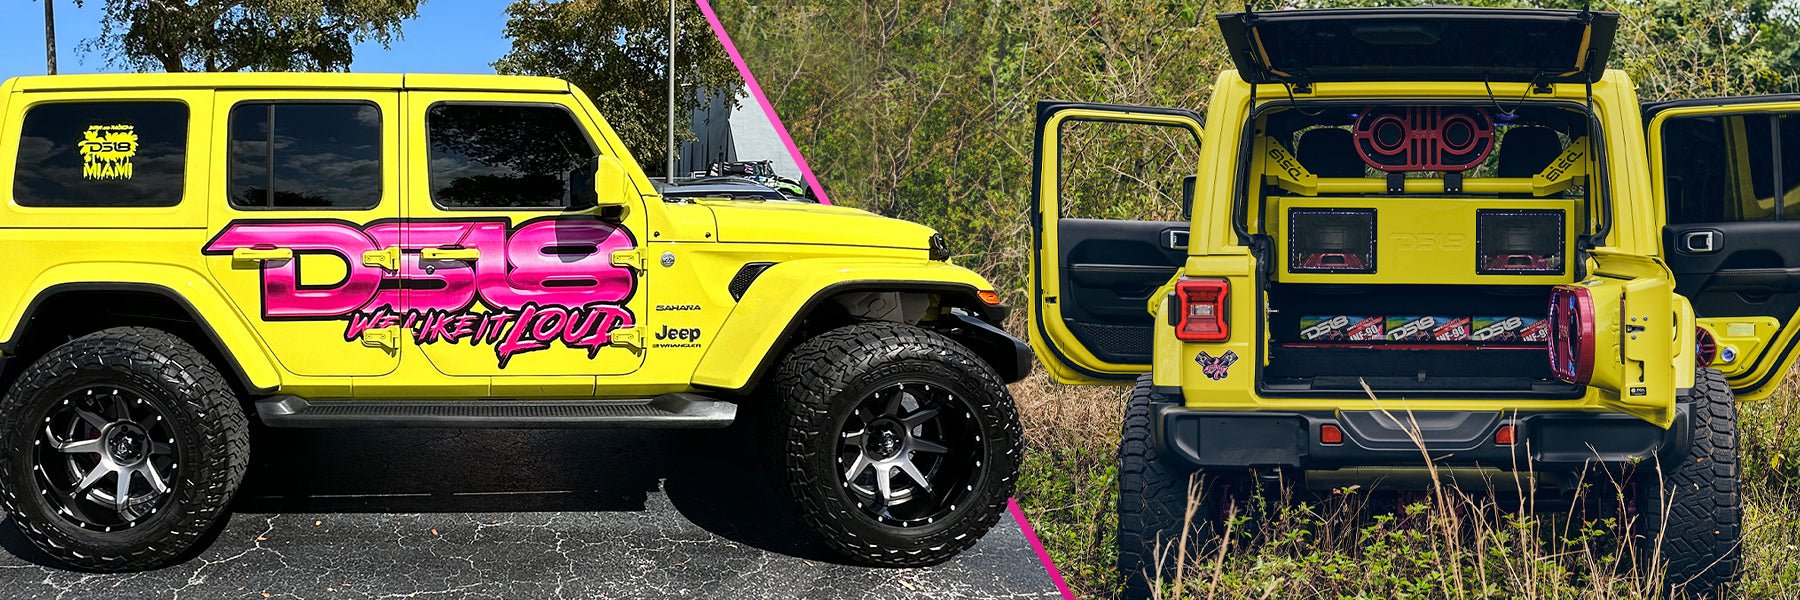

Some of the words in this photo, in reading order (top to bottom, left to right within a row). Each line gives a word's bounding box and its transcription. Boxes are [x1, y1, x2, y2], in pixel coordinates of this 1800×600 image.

[85, 142, 131, 152] DS18
[83, 162, 133, 180] MIAMI
[1268, 149, 1302, 181] DS18
[1545, 151, 1584, 182] DS18
[201, 217, 639, 320] DS18
[345, 310, 400, 339] WE
[474, 311, 517, 341] IT
[497, 303, 637, 358] LOUD
[655, 324, 701, 342] Jeep
[1300, 315, 1349, 340] DS18
[1386, 316, 1435, 341] DS18
[1474, 316, 1522, 341] DS18
